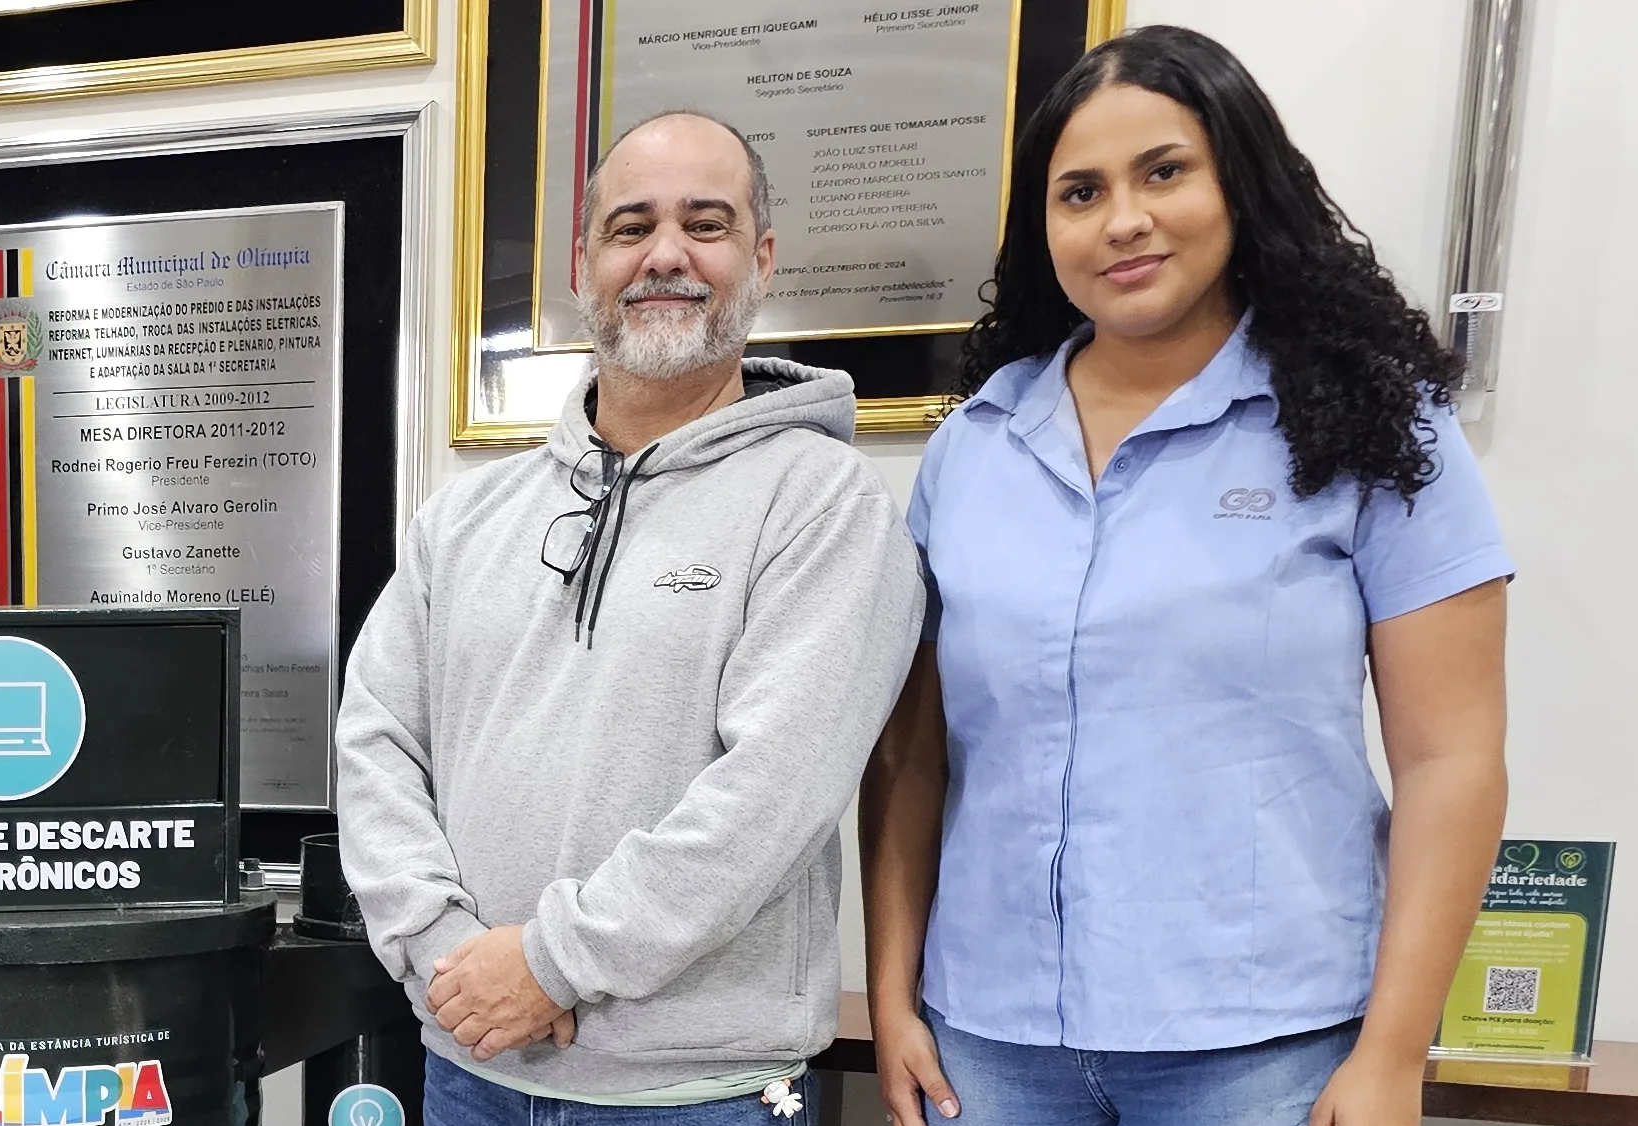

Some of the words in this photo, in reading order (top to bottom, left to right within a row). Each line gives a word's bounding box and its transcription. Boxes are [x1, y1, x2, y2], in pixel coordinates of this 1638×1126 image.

[864, 10, 898, 23] HÉLIO
[901, 7, 933, 20] LISSE
[936, 3, 979, 16] JÚNIOR
[638, 34, 680, 46] MÁRCIO
[683, 27, 739, 41] HENRIQUE
[741, 25, 761, 36] EITI
[763, 19, 817, 33] IQUEGAMI
[747, 73, 794, 85] HELITON
[797, 71, 811, 80] DE
[814, 68, 852, 79] SOUZA
[807, 125, 866, 137] SUPLENTES
[870, 124, 891, 133] QUE
[894, 119, 948, 130] TOMARAM
[951, 115, 987, 125] POSSE
[811, 178, 860, 189] LEANDRO
[863, 173, 914, 184] MARCELO
[917, 172, 940, 181] DOS
[943, 168, 986, 178] SANTOS
[46, 261, 111, 281] Câmara
[117, 255, 206, 277] Municipal
[211, 250, 231, 270] de
[237, 246, 311, 268] Olímpia
[813, 263, 866, 274] DEZEMBRO
[869, 262, 881, 270] DE
[884, 261, 906, 269] 2024
[49, 309, 91, 323] REFORMA
[93, 308, 98, 320] E
[101, 301, 172, 320] MODERNIZAÇÃO
[175, 303, 188, 316] DO
[191, 299, 225, 314] PRÉDIO
[227, 300, 233, 312] E
[235, 300, 254, 312] DAS
[256, 296, 321, 312] INSTALAÇÕES
[49, 328, 91, 342] REFORMA
[94, 325, 139, 340] TELHADO,
[142, 323, 174, 338] TROCA
[177, 322, 195, 335] DAS
[198, 317, 262, 335] INSTALAÇÕES
[96, 395, 200, 411] LEGISLATURA
[204, 391, 270, 406] 2009-2012
[80, 426, 123, 442] MESA
[127, 423, 208, 441] DIRETORA
[210, 422, 286, 438] 2011-2012
[52, 459, 101, 474] Rodnei
[105, 457, 162, 473] Rogerio
[166, 455, 200, 471] Freu
[204, 454, 258, 469] Ferezin
[262, 452, 316, 469] (TOTO)
[152, 474, 209, 486] Presidente
[87, 502, 129, 516] Primo
[133, 500, 167, 516] José
[171, 500, 219, 514] Alvaro
[223, 499, 277, 513] Gerolin
[122, 546, 182, 560] Gustavo
[186, 546, 240, 559] Zanette
[166, 589, 221, 603] Moreno
[226, 584, 275, 604] (LELÉ)
[16, 820, 195, 851] DESCARTE
[10, 1041, 25, 1051] DA
[31, 1038, 91, 1051] ESTÂNCIA
[96, 1034, 154, 1046] TURÍSTICA
[158, 1031, 170, 1040] DE
